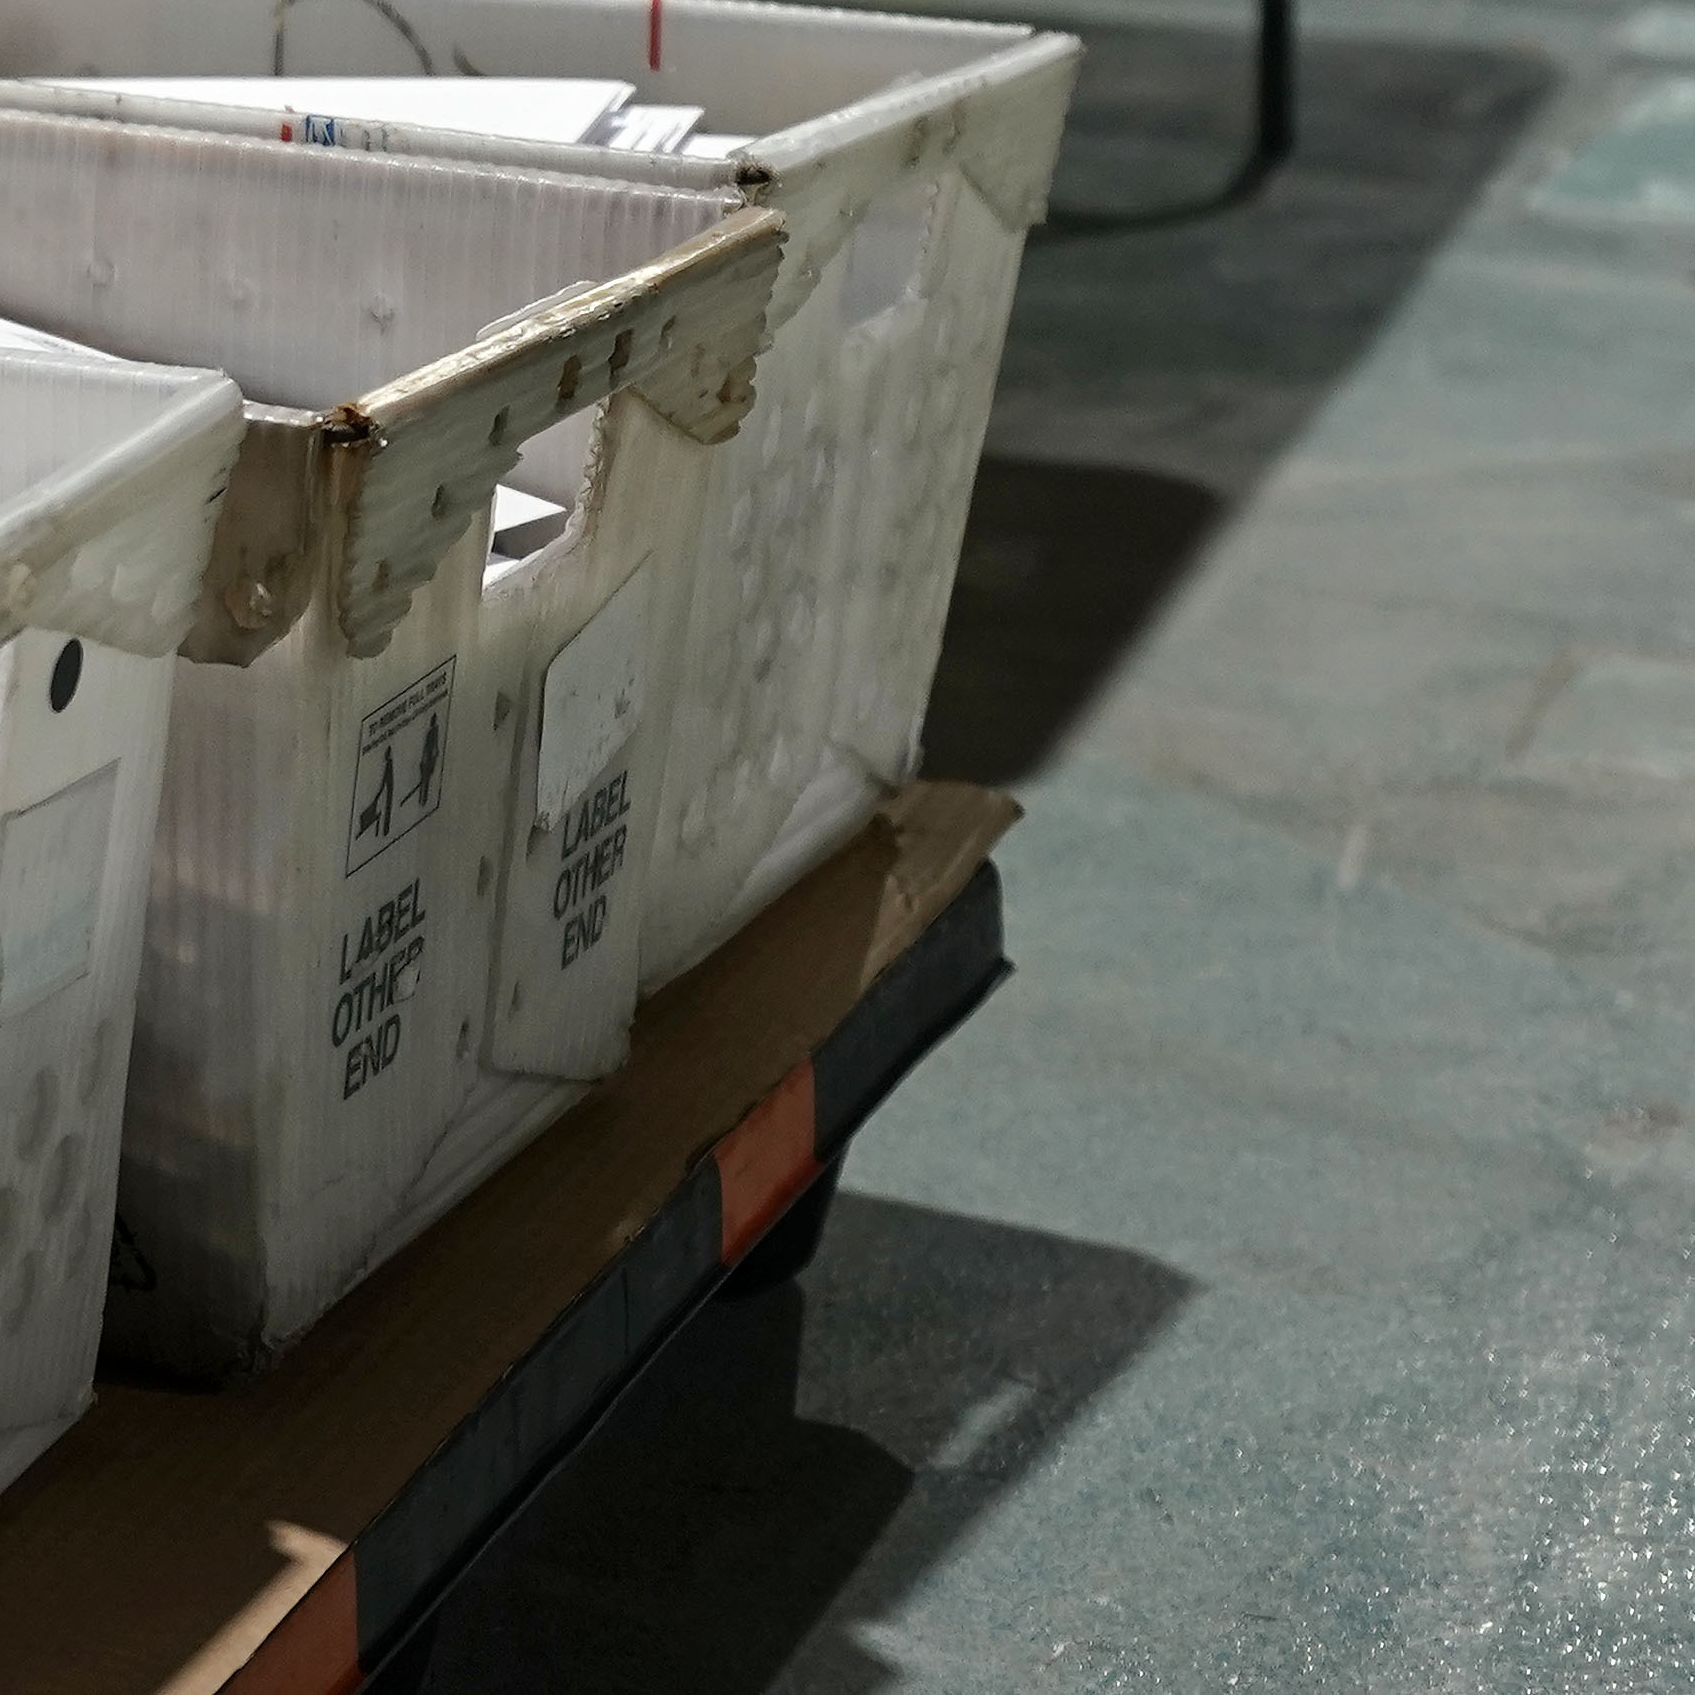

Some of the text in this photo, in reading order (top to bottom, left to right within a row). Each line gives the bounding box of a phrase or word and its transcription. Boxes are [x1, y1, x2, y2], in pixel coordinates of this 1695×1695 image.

[562, 770, 631, 860] LABEL
[553, 823, 628, 920] OTHER
[339, 876, 426, 985] LABEL
[561, 895, 607, 971] END
[343, 1013, 401, 1100] END
